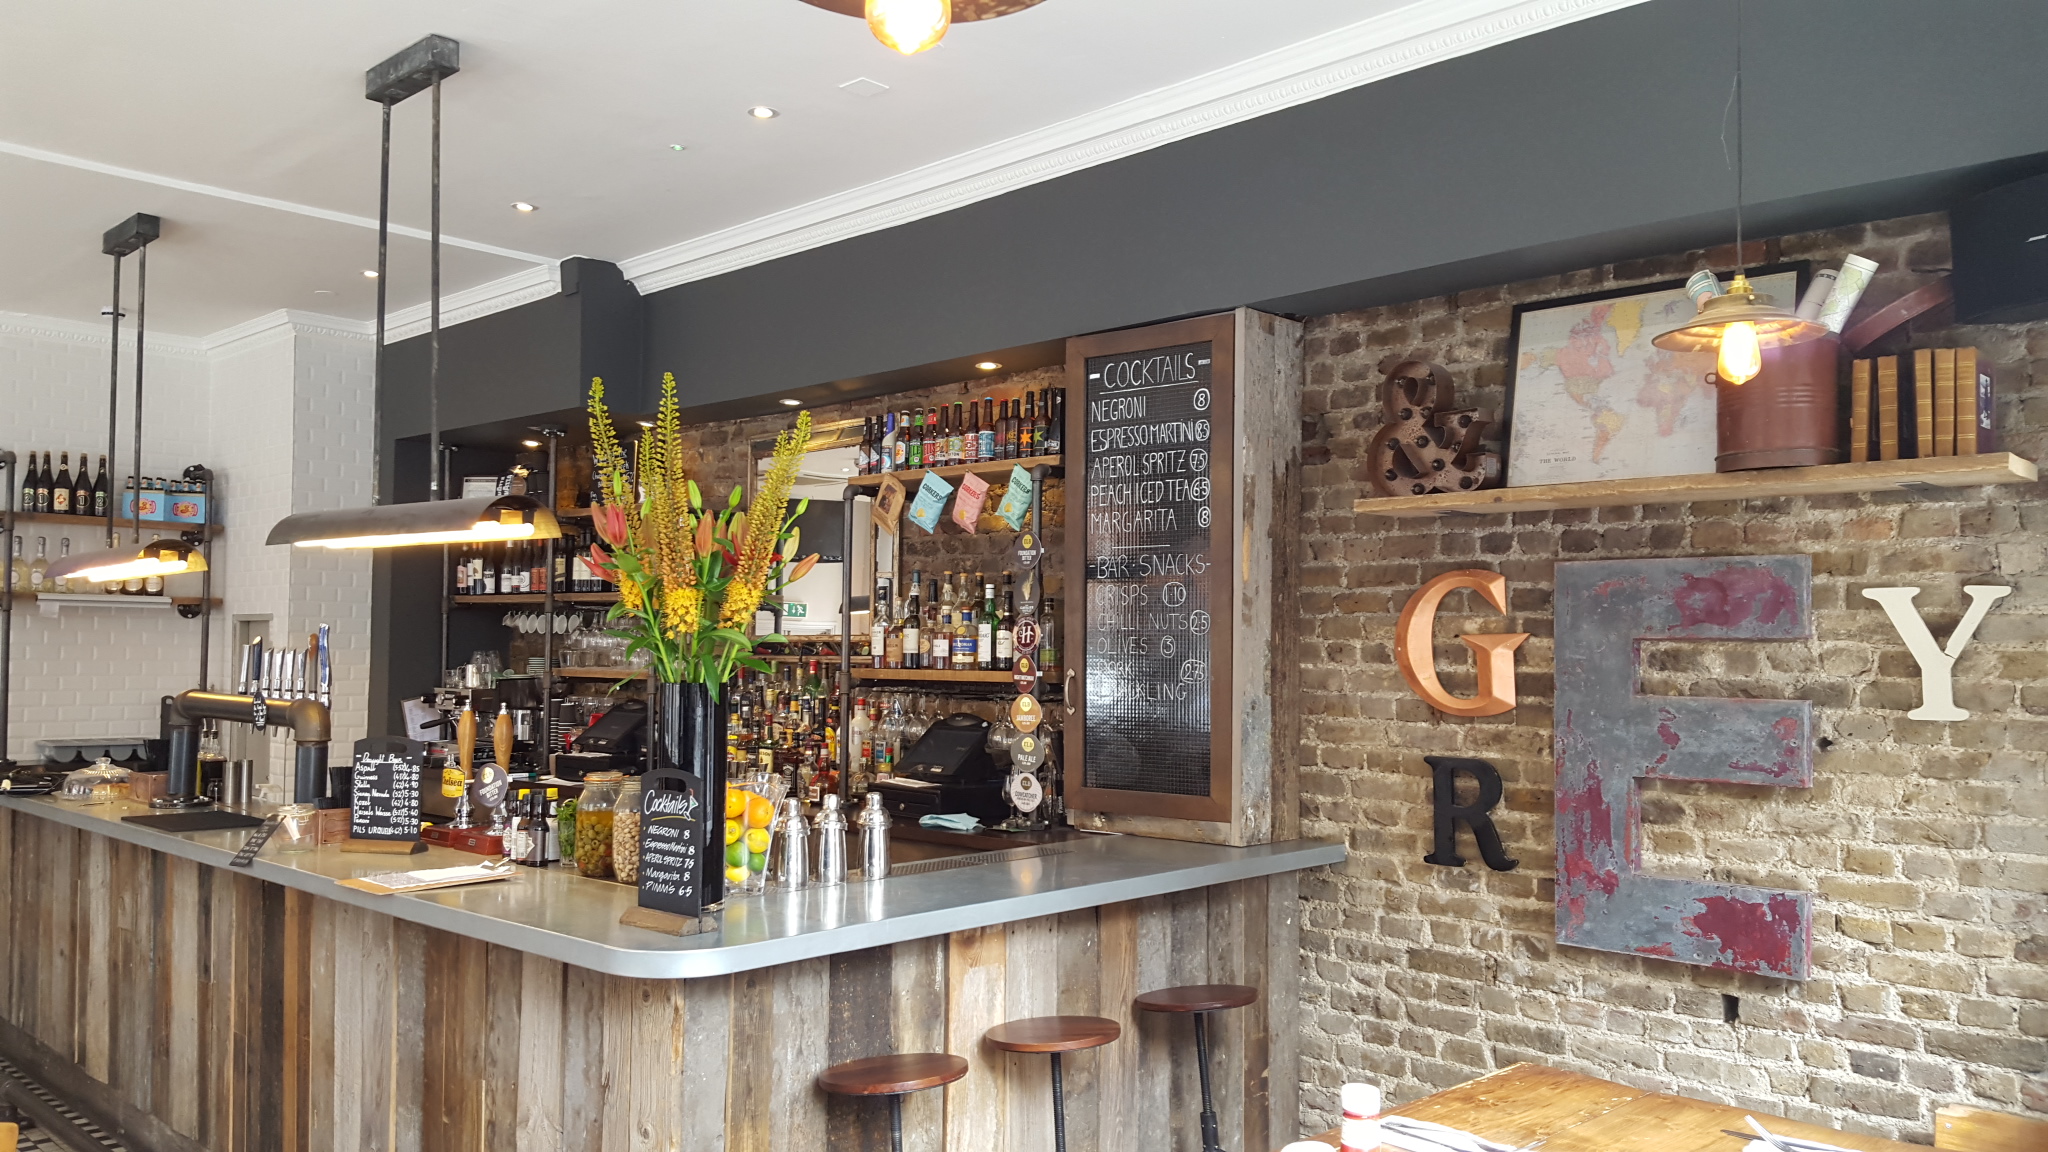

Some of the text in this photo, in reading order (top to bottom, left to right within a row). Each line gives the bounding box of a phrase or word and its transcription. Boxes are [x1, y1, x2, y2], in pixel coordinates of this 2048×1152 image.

[1104, 352, 1196, 388] COCKTAILS
[1090, 395, 1147, 423] NEGRONI
[1090, 425, 1148, 452] ESPRESSO
[1150, 419, 1194, 444] MARTINI
[1091, 455, 1140, 479] APEROL
[1143, 450, 1186, 475] SPRITZ
[922, 482, 943, 501] CORKERS
[961, 483, 981, 500] CORKERS
[1090, 483, 1132, 507] PEACH
[1135, 481, 1164, 504] ICED
[1165, 478, 1192, 502] TEA
[1090, 508, 1178, 535] MARGARITA
[1096, 583, 1149, 606] CRISPS
[1098, 611, 1140, 632] CHILLI
[1149, 612, 1188, 631] NUTS
[1098, 635, 1174, 655] OLIVES 3
[1395, 568, 1531, 717] G
[1861, 585, 2012, 721] Y
[1017, 753, 1036, 763] PALE ALE
[1554, 555, 1813, 982] E
[354, 771, 378, 780] Guinness
[644, 789, 688, 815] Cocktails
[1423, 755, 1520, 872] R
[353, 825, 366, 834] PILS
[648, 825, 690, 839] NEGRONI 8
[645, 852, 663, 864] APEROL
[663, 855, 683, 867] SPRITZ
[688, 845, 695, 856] 8
[646, 867, 691, 882] Margarita 8
